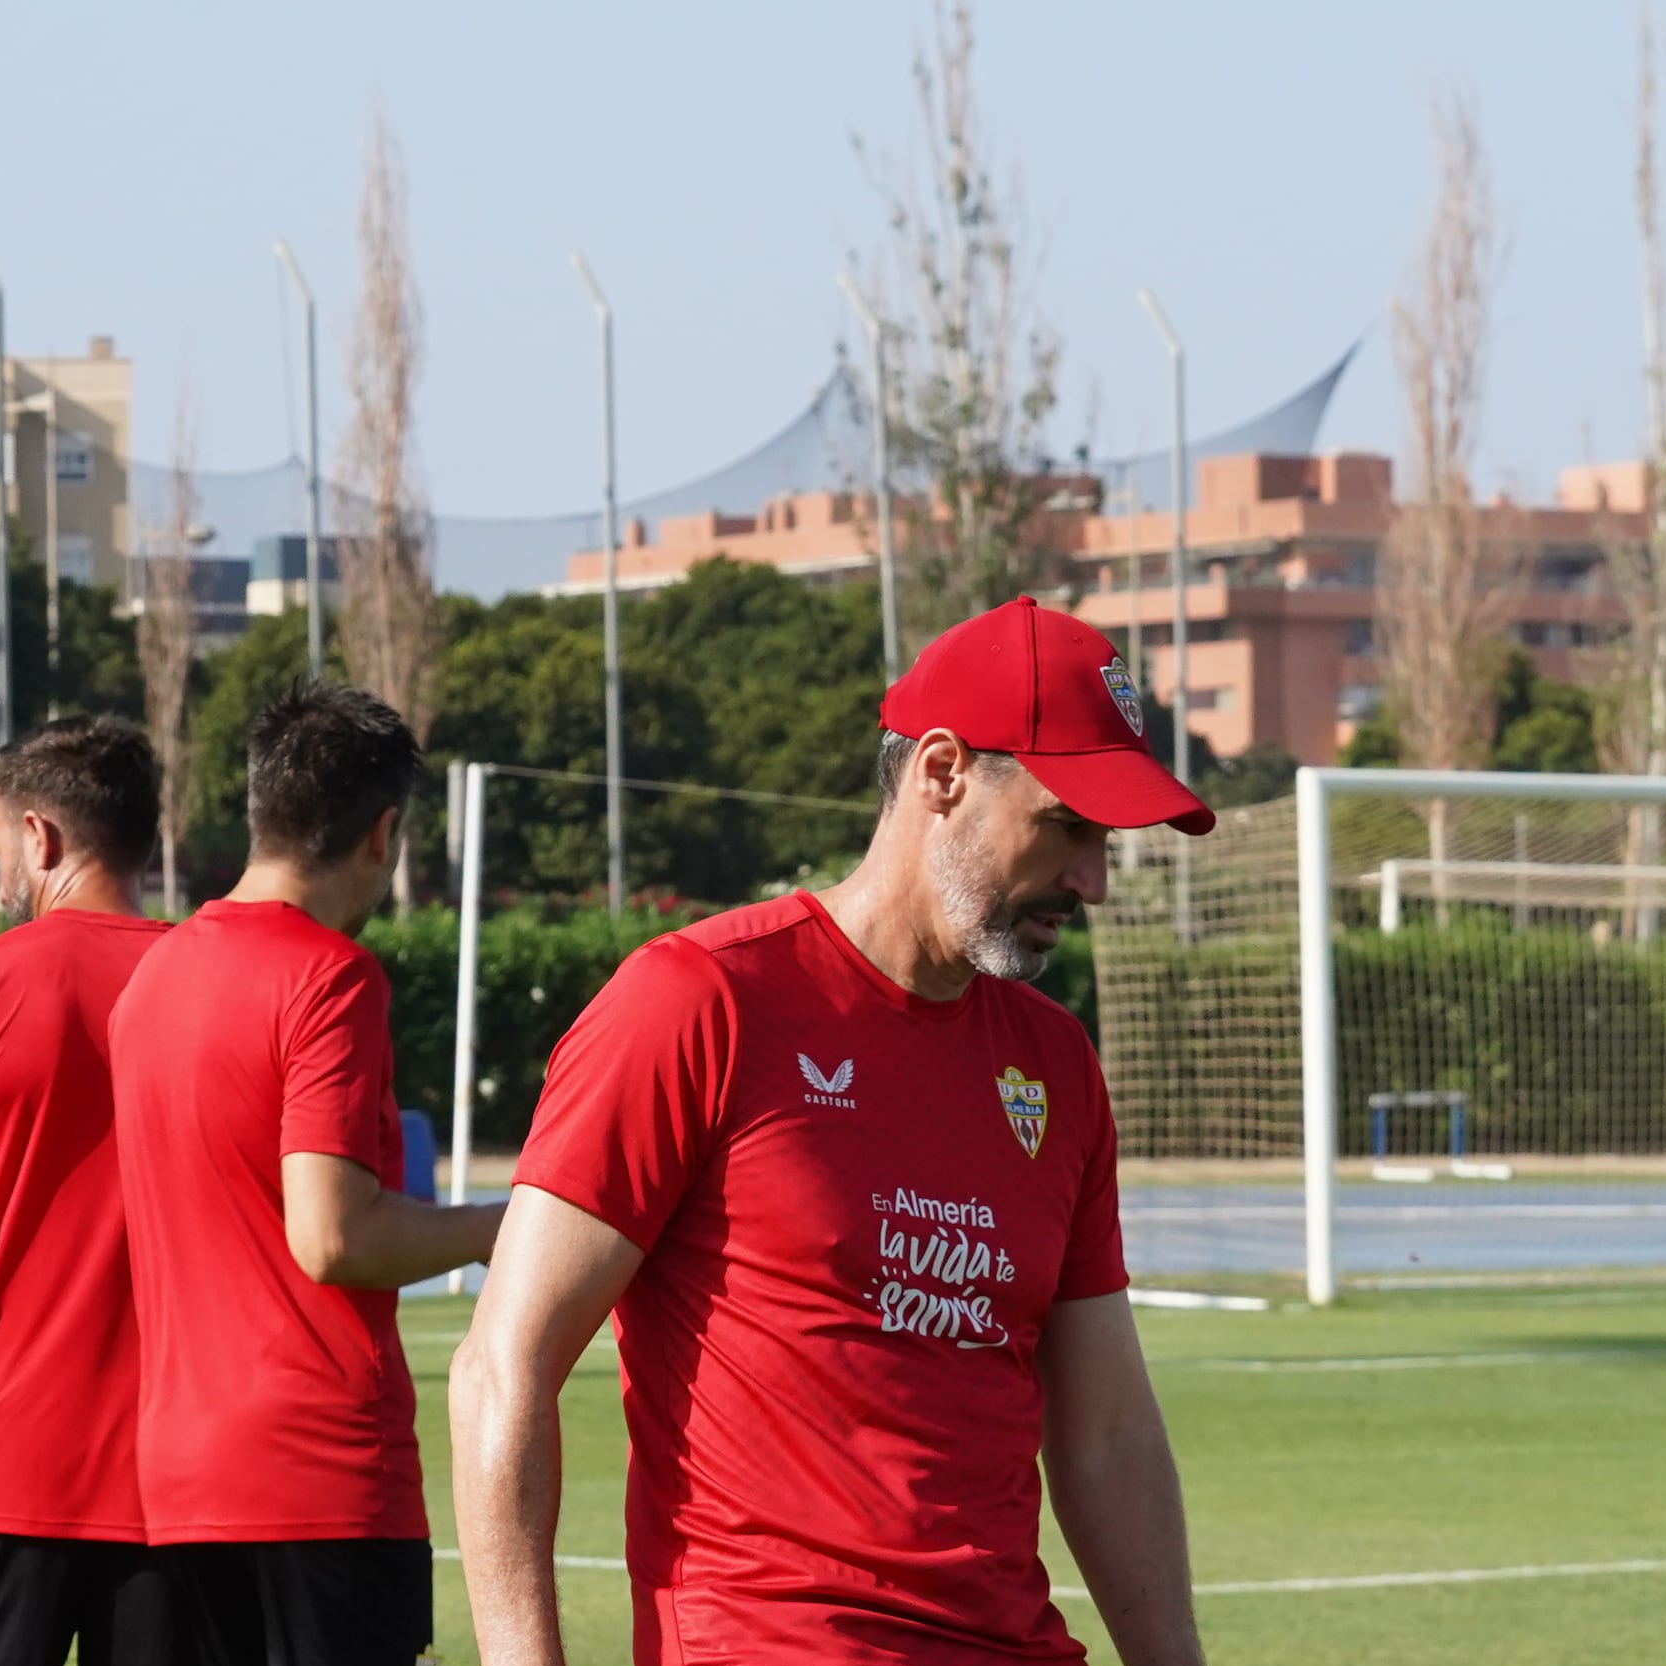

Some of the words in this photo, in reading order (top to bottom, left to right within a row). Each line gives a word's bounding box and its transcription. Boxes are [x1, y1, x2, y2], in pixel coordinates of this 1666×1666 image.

[804, 1093, 857, 1110] CASTORE
[1001, 1084, 1010, 1096] U
[1025, 1087, 1038, 1098] D
[871, 1193, 893, 1212] En
[895, 1187, 995, 1228] Almería
[880, 1218, 905, 1259] la
[909, 1226, 990, 1285] vida
[995, 1248, 1016, 1282] te
